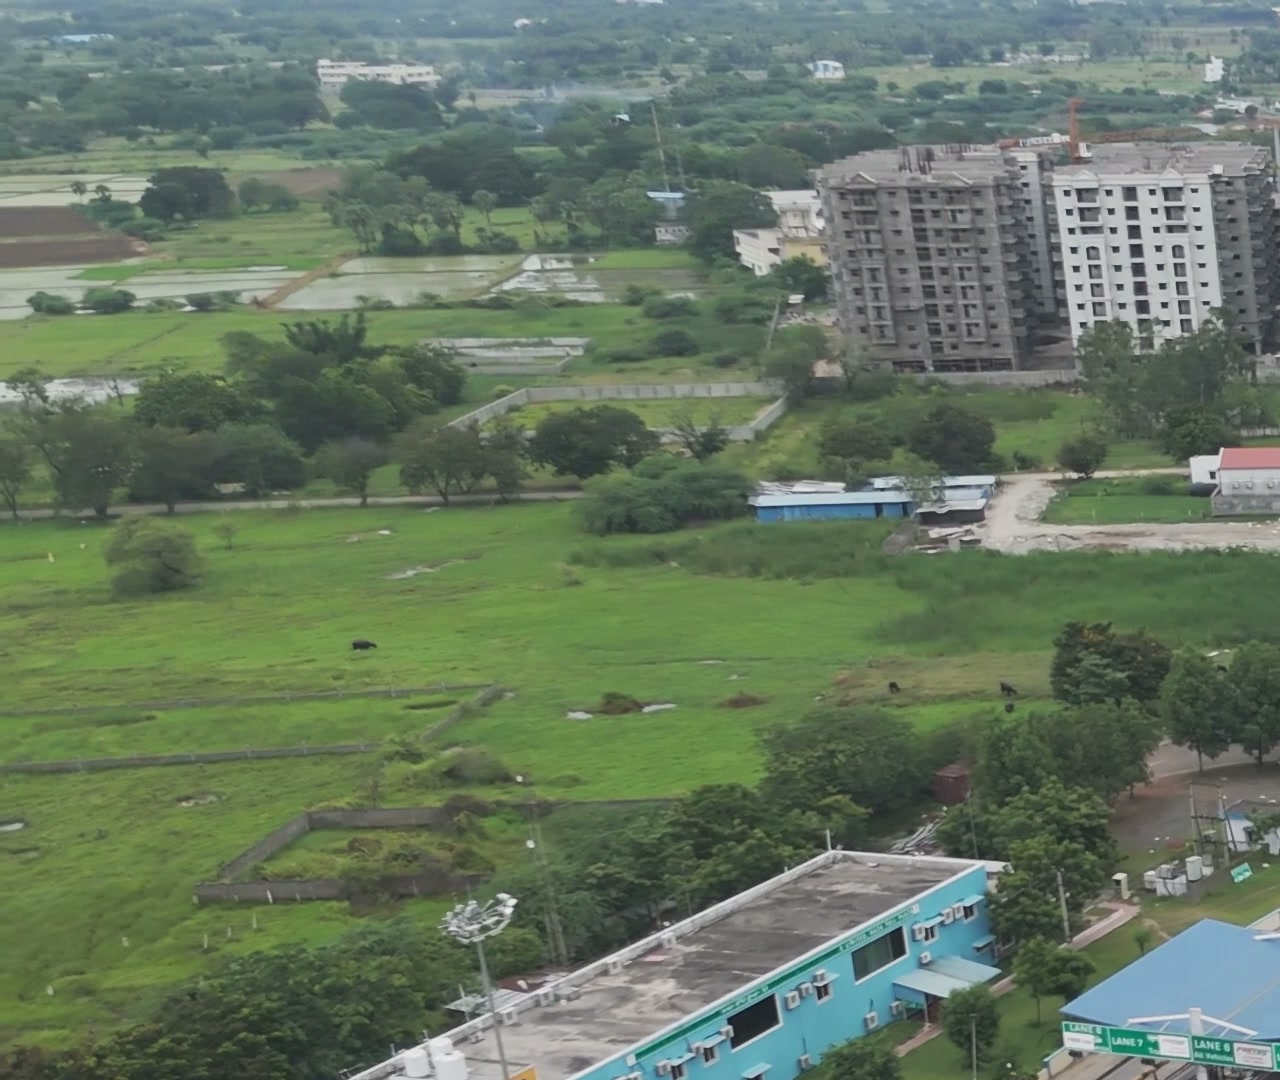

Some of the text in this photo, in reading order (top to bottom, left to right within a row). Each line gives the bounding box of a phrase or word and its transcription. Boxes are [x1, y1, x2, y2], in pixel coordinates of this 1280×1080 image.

[1069, 1024, 1094, 1034] LANE
[1111, 1037, 1144, 1047] LANE 7
[1194, 1040, 1220, 1051] LANE
